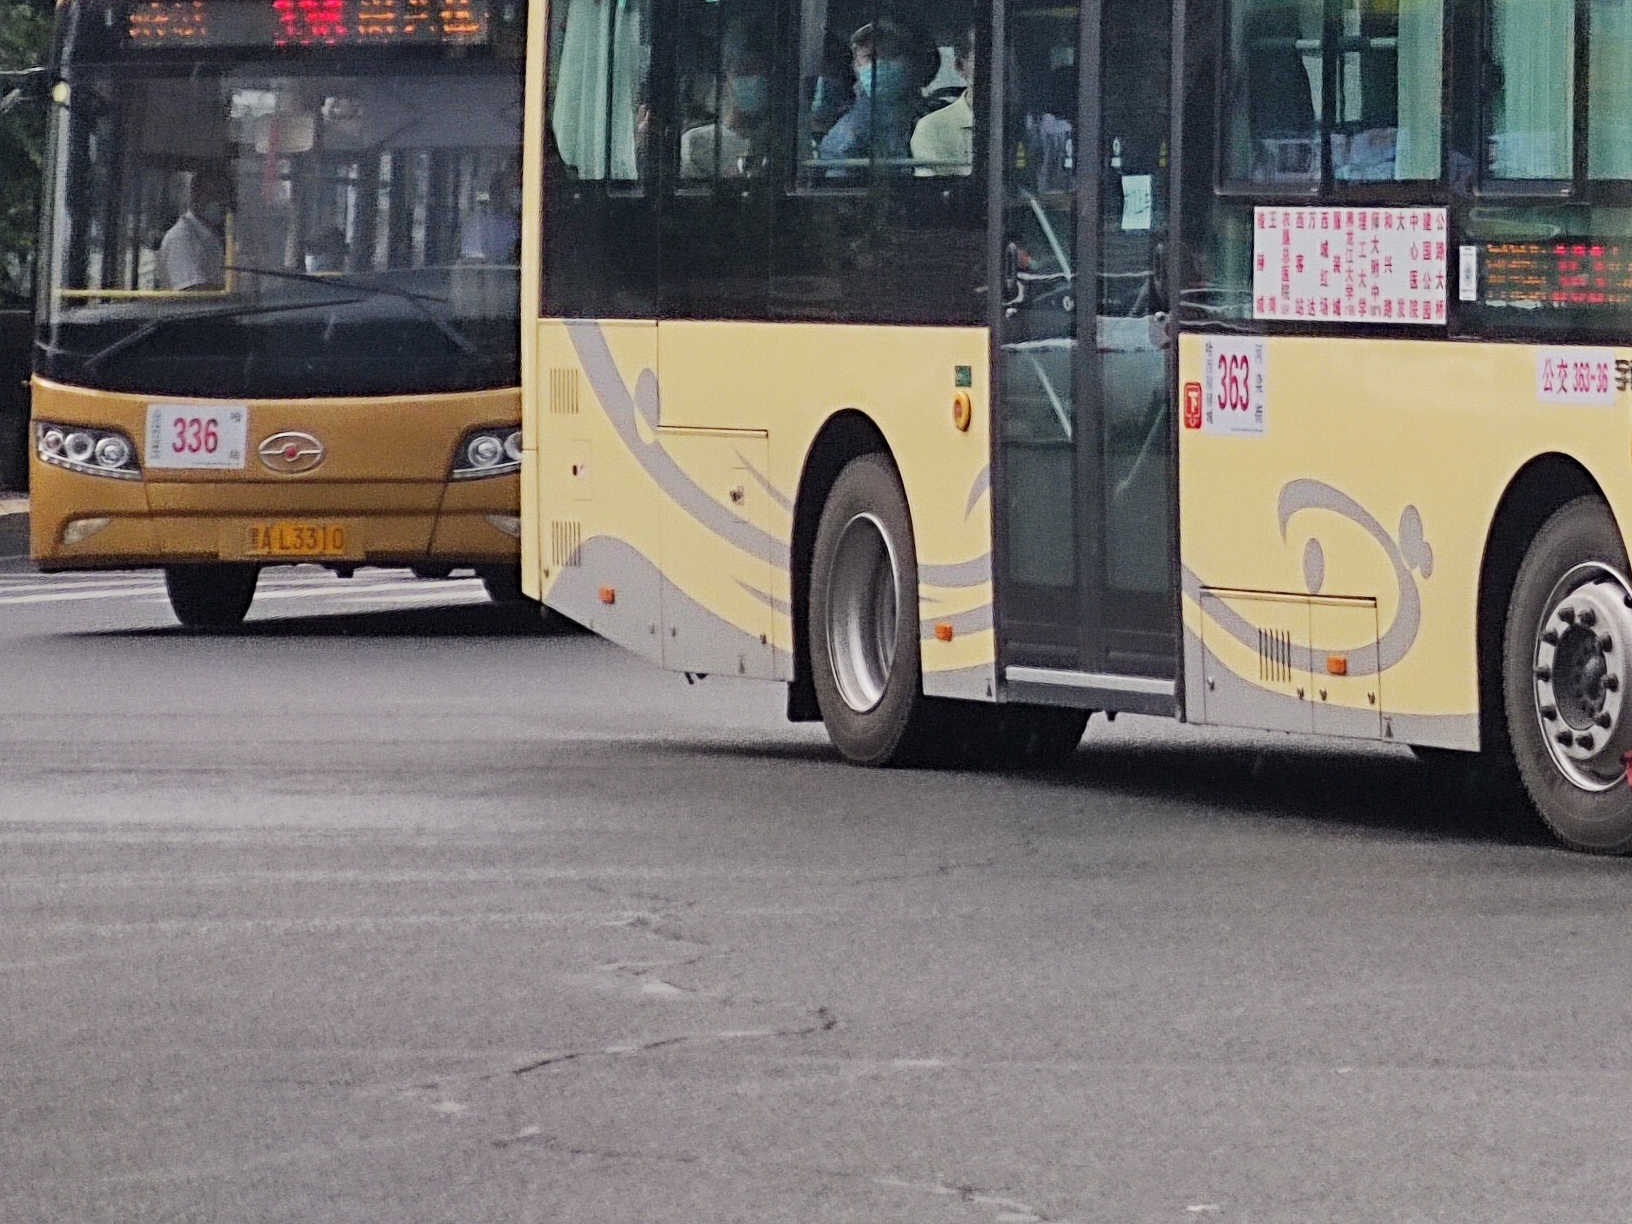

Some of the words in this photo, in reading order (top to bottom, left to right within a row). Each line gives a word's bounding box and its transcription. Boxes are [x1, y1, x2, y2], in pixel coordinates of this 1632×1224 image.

[1409, 212, 1419, 319] 中心医院
[1217, 354, 1250, 412] 363
[1542, 358, 1568, 394] 公交
[172, 417, 219, 454] 336
